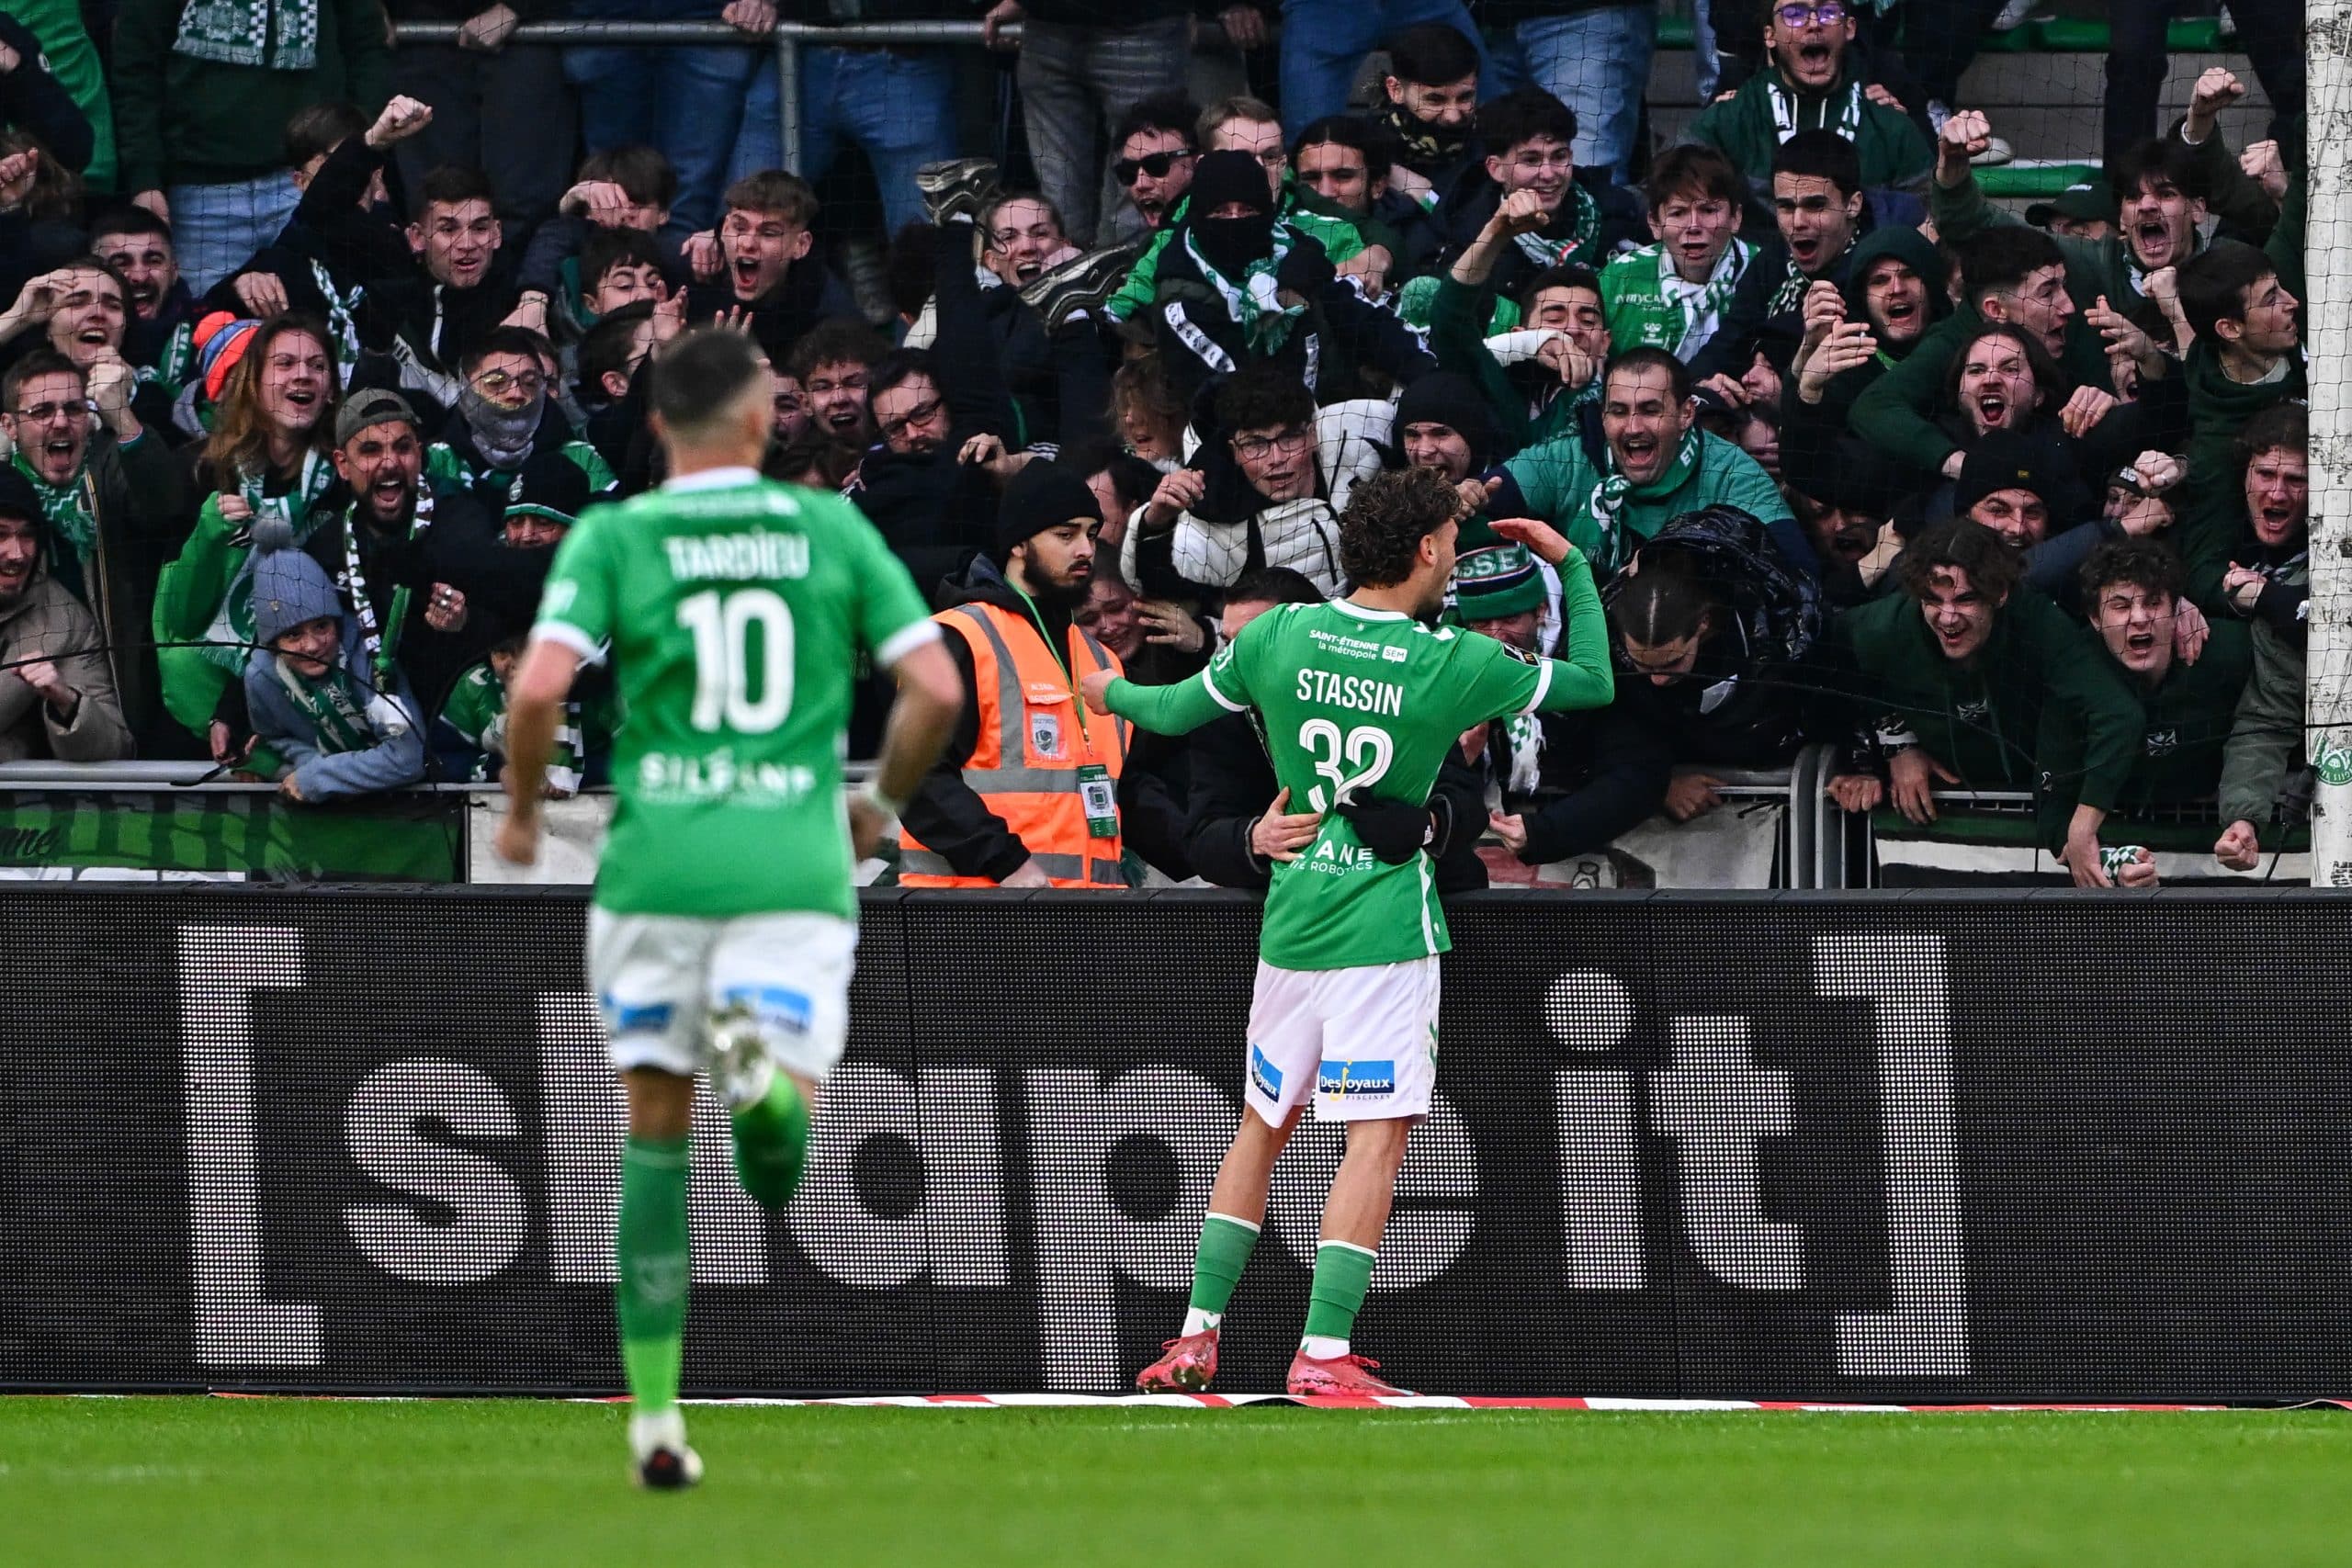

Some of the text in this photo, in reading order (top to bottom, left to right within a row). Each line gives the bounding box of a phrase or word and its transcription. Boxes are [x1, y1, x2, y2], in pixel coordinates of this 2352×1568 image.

[675, 590, 796, 733] 10
[1309, 629, 1380, 651] SAINT-ÉTIENNE
[1317, 640, 1377, 660] la métropole
[1385, 649, 1405, 659] SEM
[1296, 668, 1404, 717] STASSIN
[1298, 717, 1395, 816] 32
[1319, 1059, 1390, 1100] Desjoyaux
[1540, 933, 1972, 1378] it]
